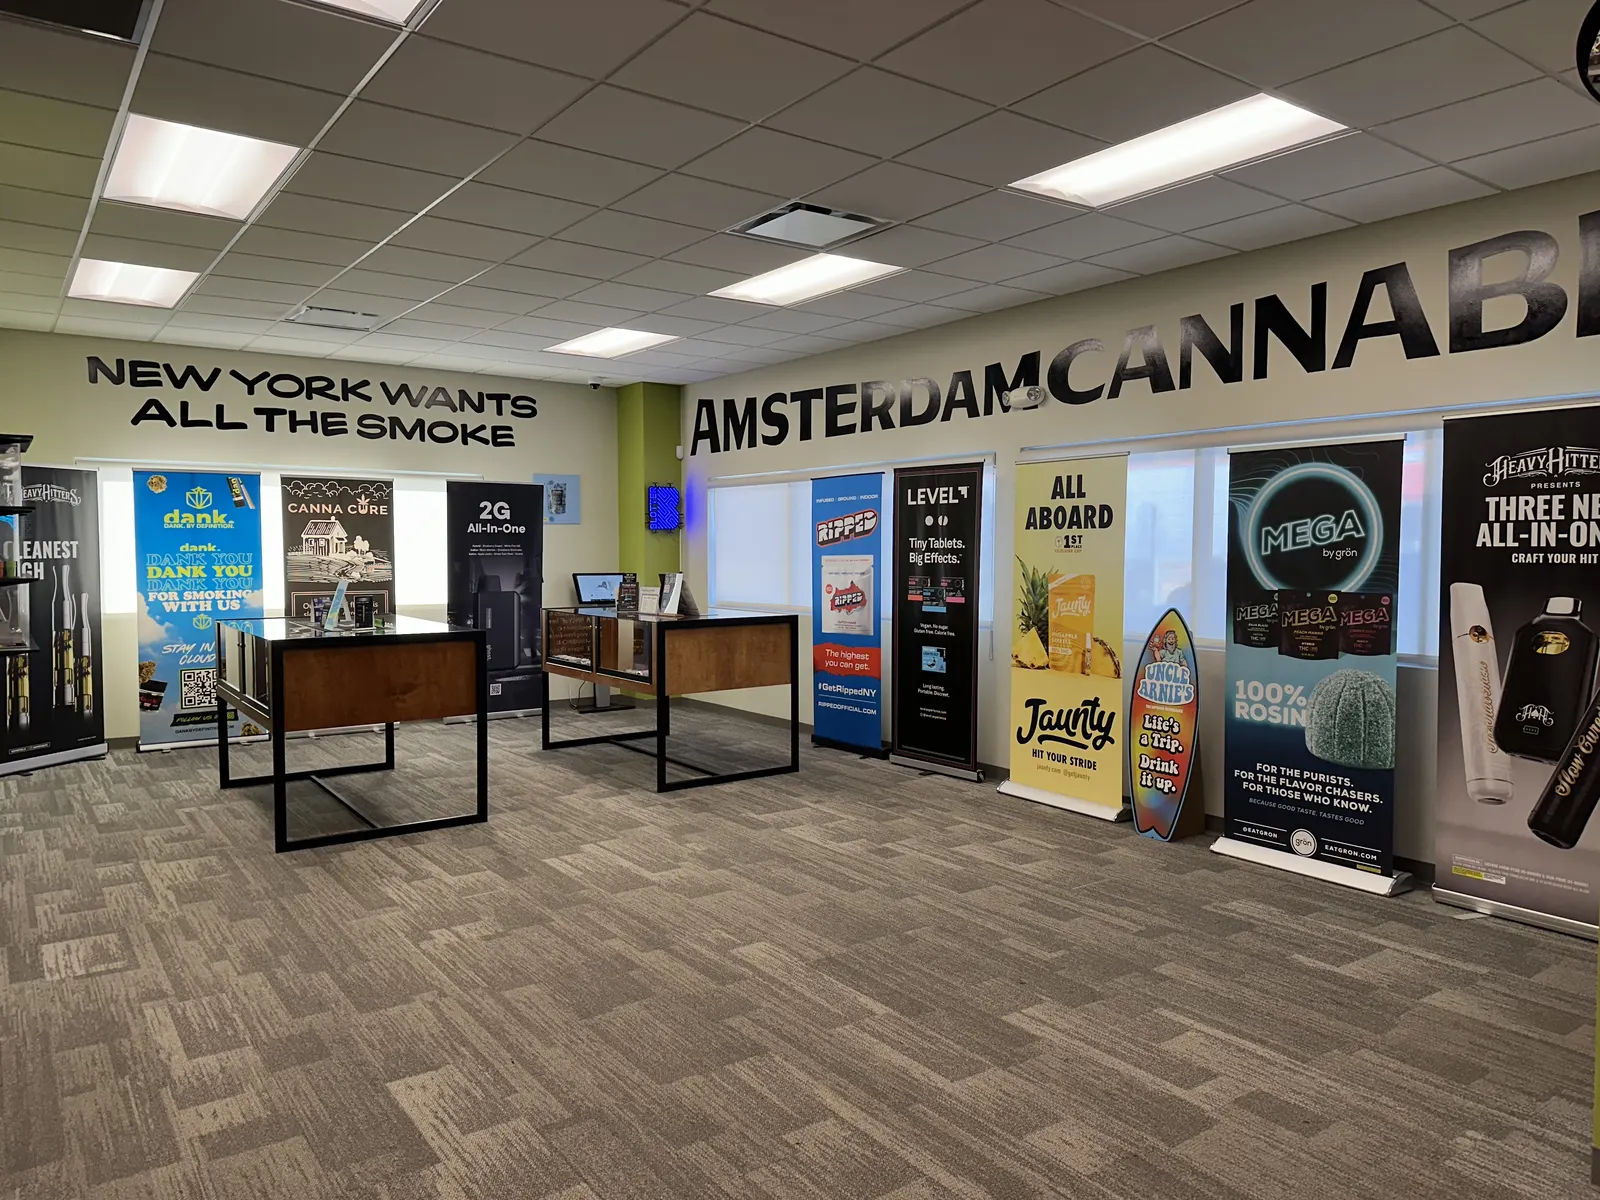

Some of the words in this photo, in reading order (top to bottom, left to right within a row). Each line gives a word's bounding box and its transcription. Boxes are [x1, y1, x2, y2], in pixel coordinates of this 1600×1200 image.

[87, 356, 222, 392] NEW
[228, 370, 373, 403] YORK
[380, 381, 538, 418] WANTS
[131, 398, 247, 430] ALL
[254, 406, 348, 437] THE
[356, 413, 515, 447] SMOKE
[1546, 446, 1600, 475] HITTE
[1051, 474, 1086, 499] ALL
[1530, 481, 1581, 489] PRESENTS
[907, 486, 959, 505] LEVEL
[288, 503, 343, 514] CANNA
[479, 501, 510, 520] 2G
[1025, 504, 1113, 530] ABOARD
[1485, 494, 1566, 521] THREE
[467, 523, 526, 533] All-In-One
[818, 510, 877, 543] RIPPED
[1261, 509, 1365, 556] MEGA
[909, 538, 927, 551] Tiny
[928, 538, 965, 549] Tablets.
[1322, 548, 1335, 559] by
[1335, 547, 1358, 560] grön
[146, 553, 207, 566] DANK
[212, 553, 252, 564] YOU
[909, 552, 923, 566] Big
[925, 552, 960, 563] Effects.
[1511, 553, 1544, 564] CRAFT
[1547, 553, 1576, 564] YOUR
[1580, 553, 1599, 564] HIT
[147, 566, 207, 578] DANK
[212, 565, 253, 577] YOU
[147, 578, 207, 591] DANK
[212, 577, 253, 589] YOU
[148, 592, 179, 601] FOR
[162, 601, 212, 612] WITH
[217, 600, 240, 610] US
[1052, 595, 1091, 619] Jaunty
[1281, 606, 1337, 627] MEGA
[162, 643, 195, 654] STAY
[825, 649, 838, 658] The
[841, 651, 869, 660] highest
[840, 661, 853, 669] can
[1147, 664, 1188, 684] UNCLE
[818, 682, 876, 697] #GetRippedNY
[1139, 683, 1193, 703] ARNIE'S
[1235, 680, 1307, 706] 100%
[818, 701, 877, 715] RIPPEDOFFICIAL.COM
[1235, 702, 1308, 727] ROSIN
[1016, 697, 1116, 750] Jaunty
[1143, 715, 1180, 733] Life's
[1140, 735, 1149, 746] a
[1151, 733, 1183, 752] Trip.
[1555, 753, 1585, 796] Slow
[1574, 706, 1600, 754] Cure
[1032, 749, 1043, 759] HIT
[1046, 751, 1067, 764] YOUR
[1069, 756, 1097, 770] STRIDE
[1139, 755, 1179, 775] Drink
[1140, 773, 1153, 787] it
[1155, 778, 1176, 793] up.
[1256, 762, 1277, 774] FOR
[1280, 766, 1300, 778] THE
[1303, 771, 1354, 788] PURISTS.
[1234, 769, 1255, 781] FOR
[1256, 773, 1277, 785] THE
[1279, 778, 1323, 793] FLAVOR
[1325, 786, 1383, 804] CHASERS.
[1242, 781, 1263, 793] FOR
[1265, 785, 1300, 800] THOSE
[1303, 792, 1330, 805] WHO
[1333, 799, 1372, 813] KNOW.
[1249, 798, 1276, 808] BECAUSE
[1278, 803, 1295, 812] GOOD
[1319, 811, 1344, 821] TASTES
[1344, 815, 1365, 825] GOOD
[1242, 826, 1278, 838] @EATGRON
[1324, 844, 1377, 861] EATGRON.COM
